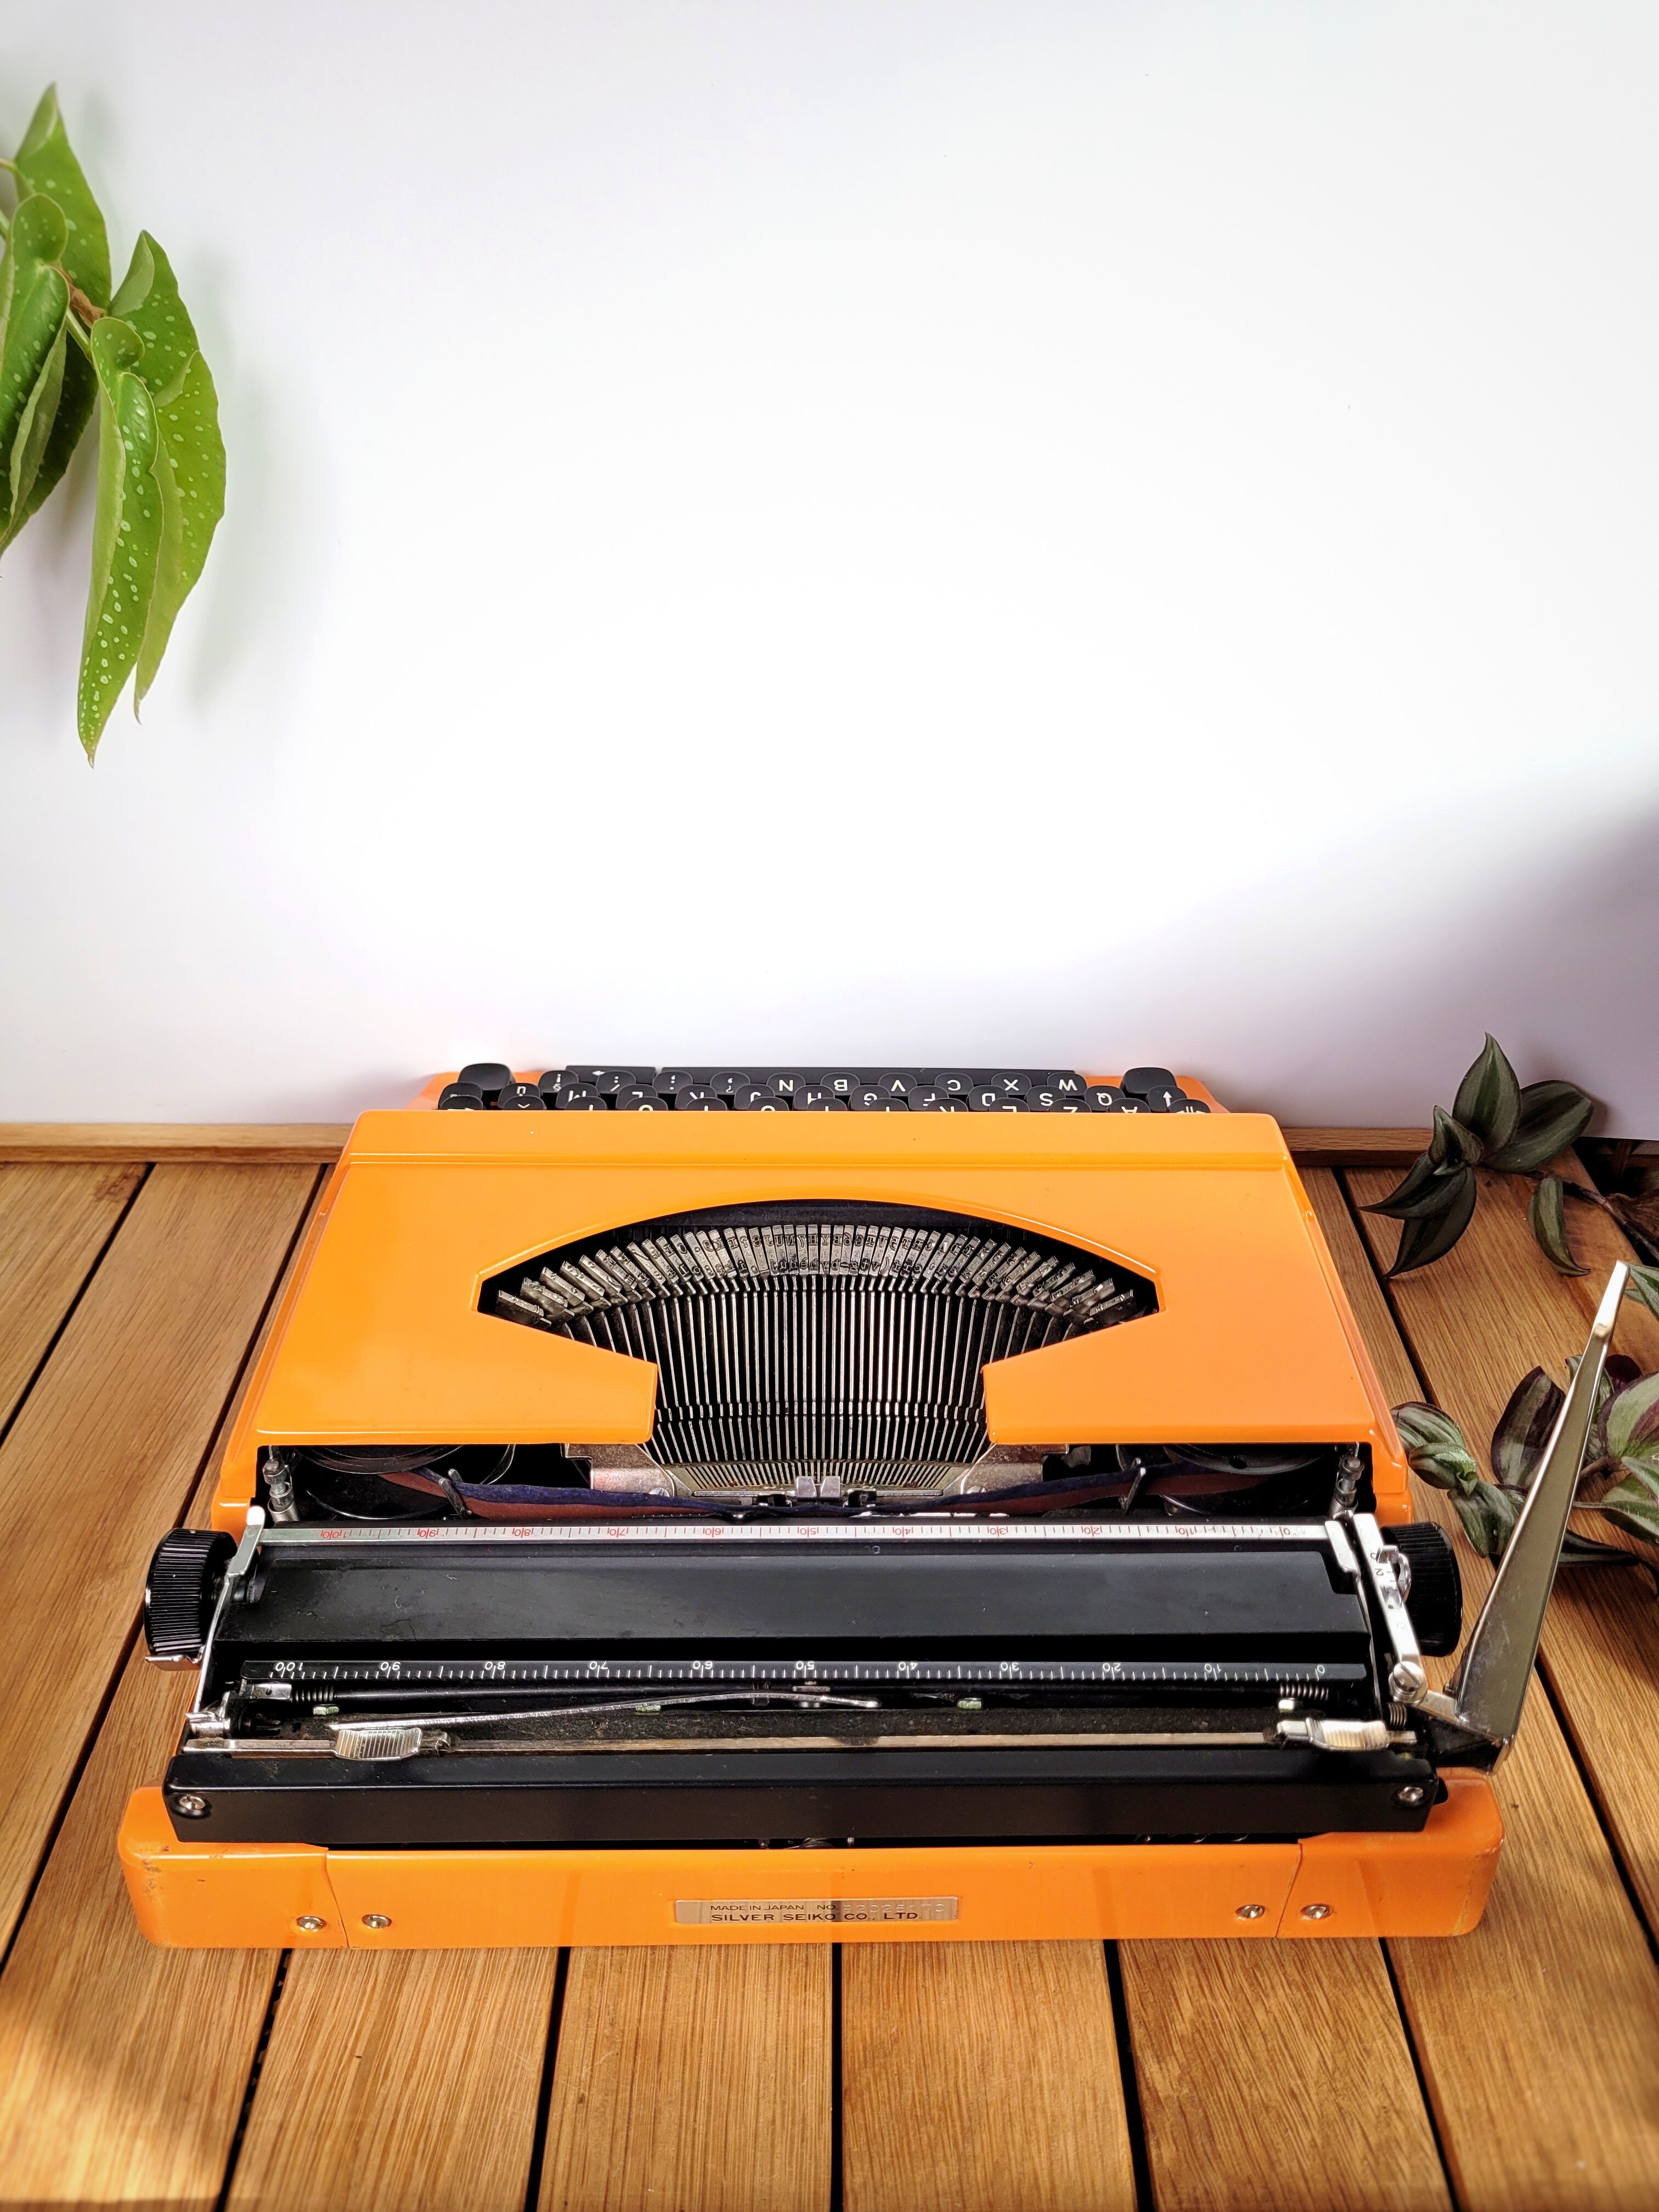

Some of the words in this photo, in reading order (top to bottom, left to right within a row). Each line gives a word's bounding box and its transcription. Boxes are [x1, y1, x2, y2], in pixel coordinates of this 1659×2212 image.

[778, 1079, 793, 1092] N
[833, 1079, 848, 1091] B
[890, 1080, 906, 1092] V
[947, 1079, 961, 1091] C
[1003, 1079, 1019, 1091] X
[864, 1093, 878, 1106] G
[981, 1093, 996, 1107] D
[1039, 1093, 1053, 1107] S
[1096, 1092, 1113, 1106] Q
[275, 1662, 303, 1672] 100
[380, 1662, 401, 1671] 90
[485, 1661, 506, 1671] 80
[589, 1661, 608, 1670] 70
[693, 1661, 713, 1670] 60
[795, 1661, 815, 1670] 50
[898, 1662, 918, 1671] 40
[1000, 1662, 1020, 1672] 30
[1102, 1663, 1121, 1672] 20
[1204, 1663, 1222, 1673] 10
[1316, 1664, 1325, 1673] 0
[883, 1912, 922, 1920] LTD.
